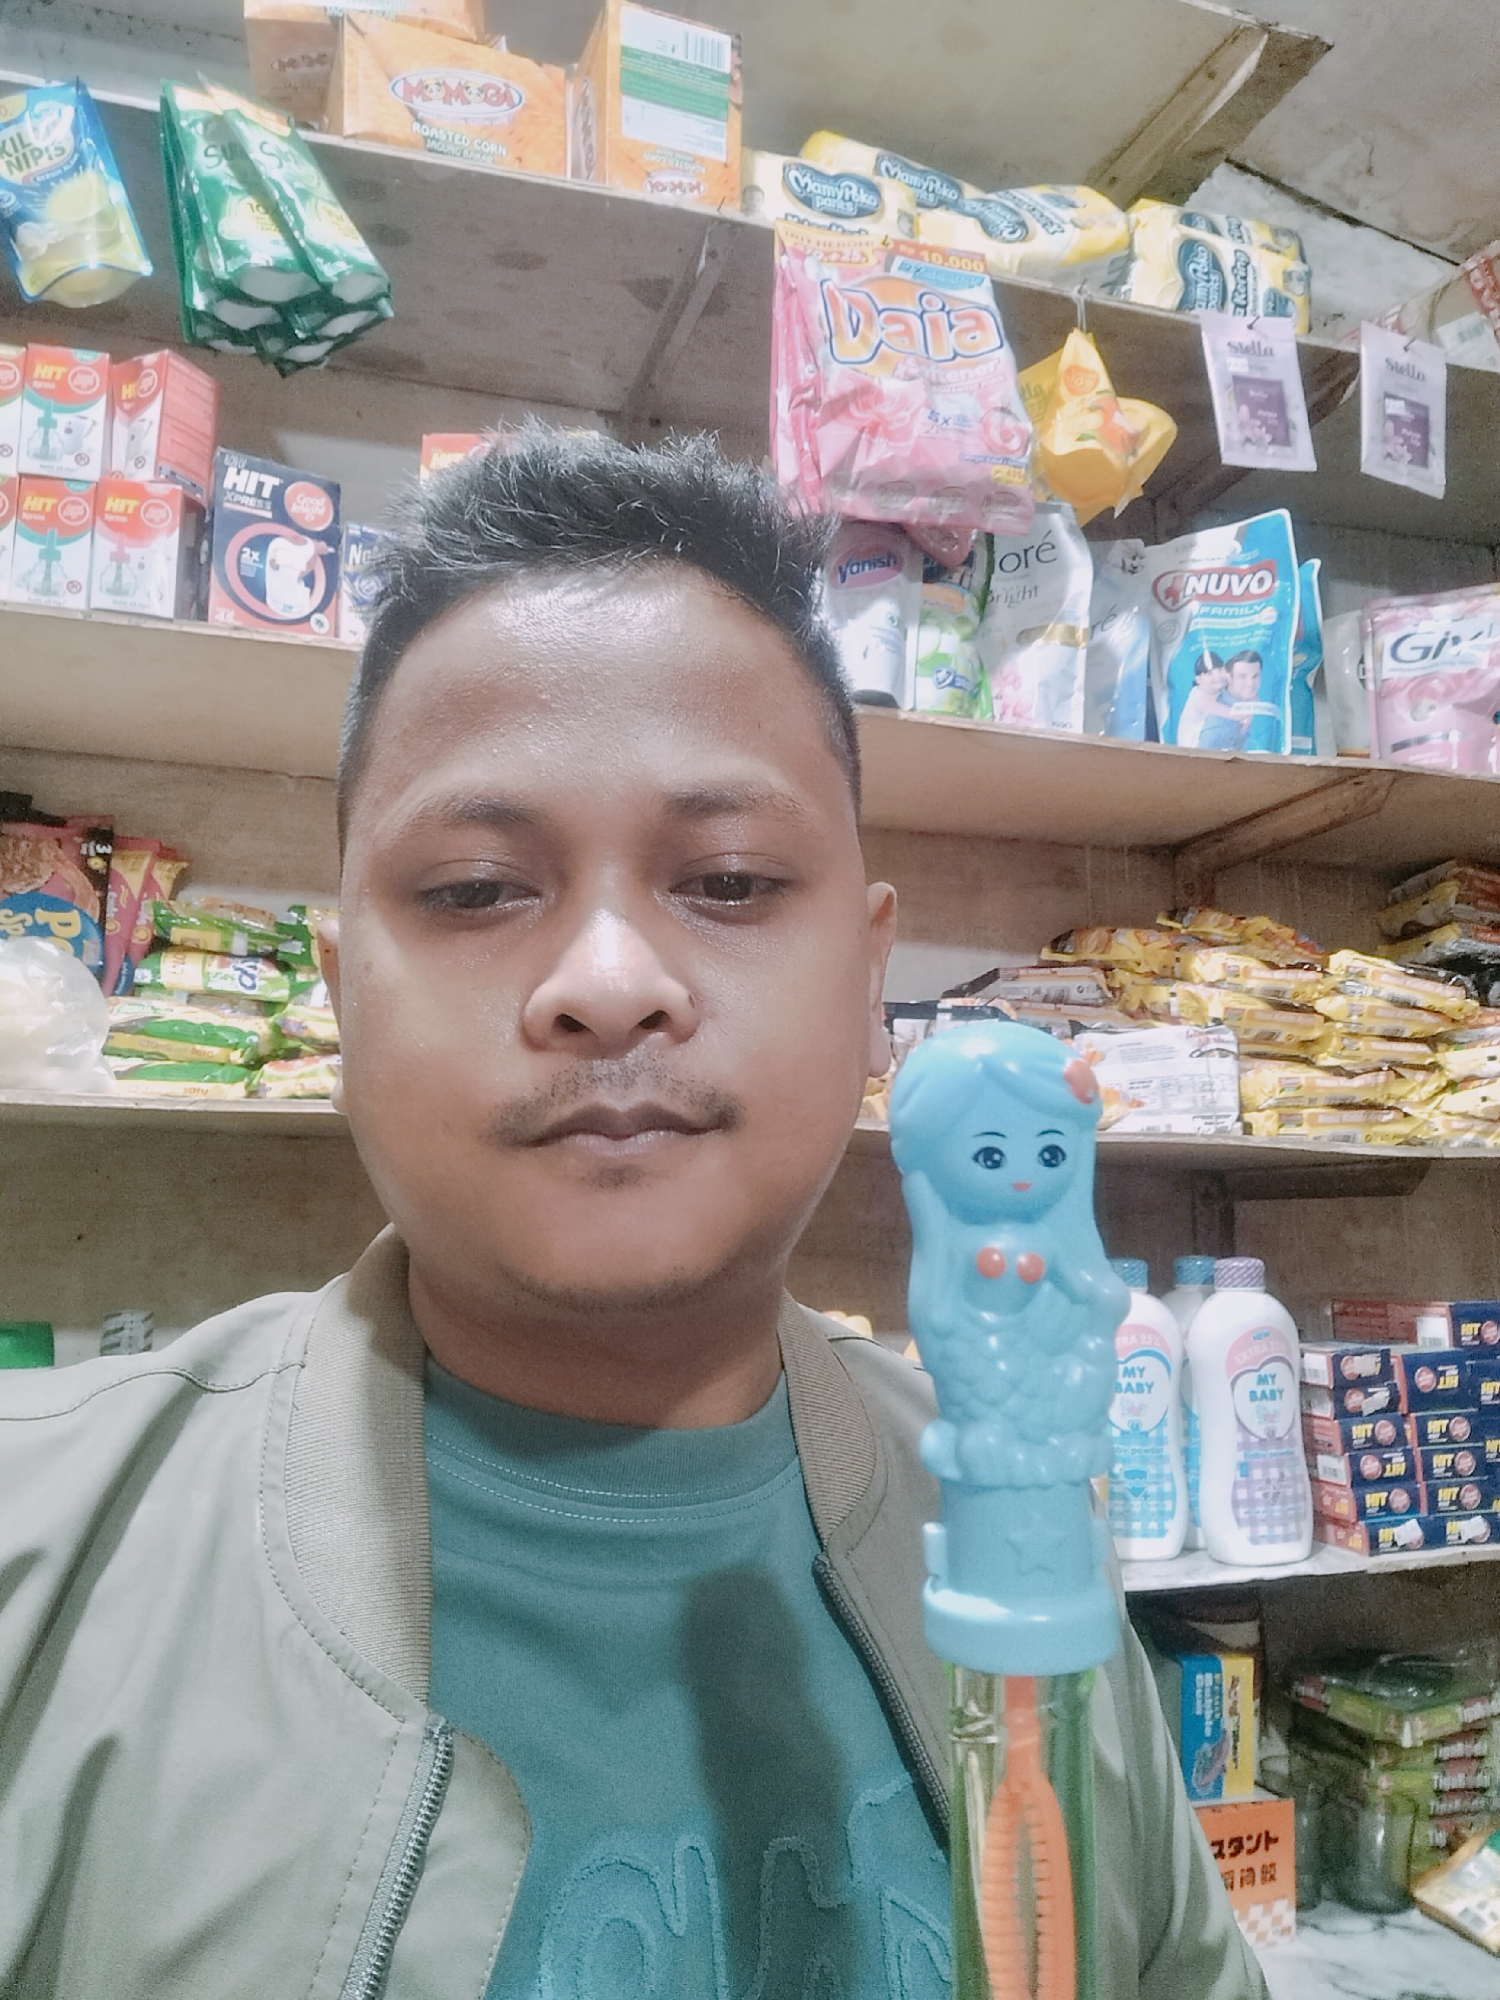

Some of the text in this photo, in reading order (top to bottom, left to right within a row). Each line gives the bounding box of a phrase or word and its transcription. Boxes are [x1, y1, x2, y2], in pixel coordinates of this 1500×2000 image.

[412, 121, 507, 157] ROASTED CORN
[921, 250, 985, 274] 10.000
[821, 280, 1004, 363] Daia
[33, 364, 68, 380] HIT
[223, 467, 279, 499] HIT
[22, 495, 58, 512] HIT
[104, 496, 139, 514] HIT
[999, 530, 1058, 574] oré
[838, 551, 897, 584] Vanish
[1183, 569, 1274, 598] NUVO
[1200, 602, 1266, 617] FAMILY
[1461, 1322, 1482, 1336] HIT
[1122, 1365, 1146, 1379] MY
[1256, 1373, 1277, 1386] MY
[1249, 1388, 1284, 1402] BABY
[1352, 1423, 1374, 1439] HIT
[1427, 1419, 1449, 1434] HIT
[1433, 1453, 1454, 1468] HIT
[1365, 1491, 1388, 1508] HIT
[1438, 1486, 1460, 1501] HIT
